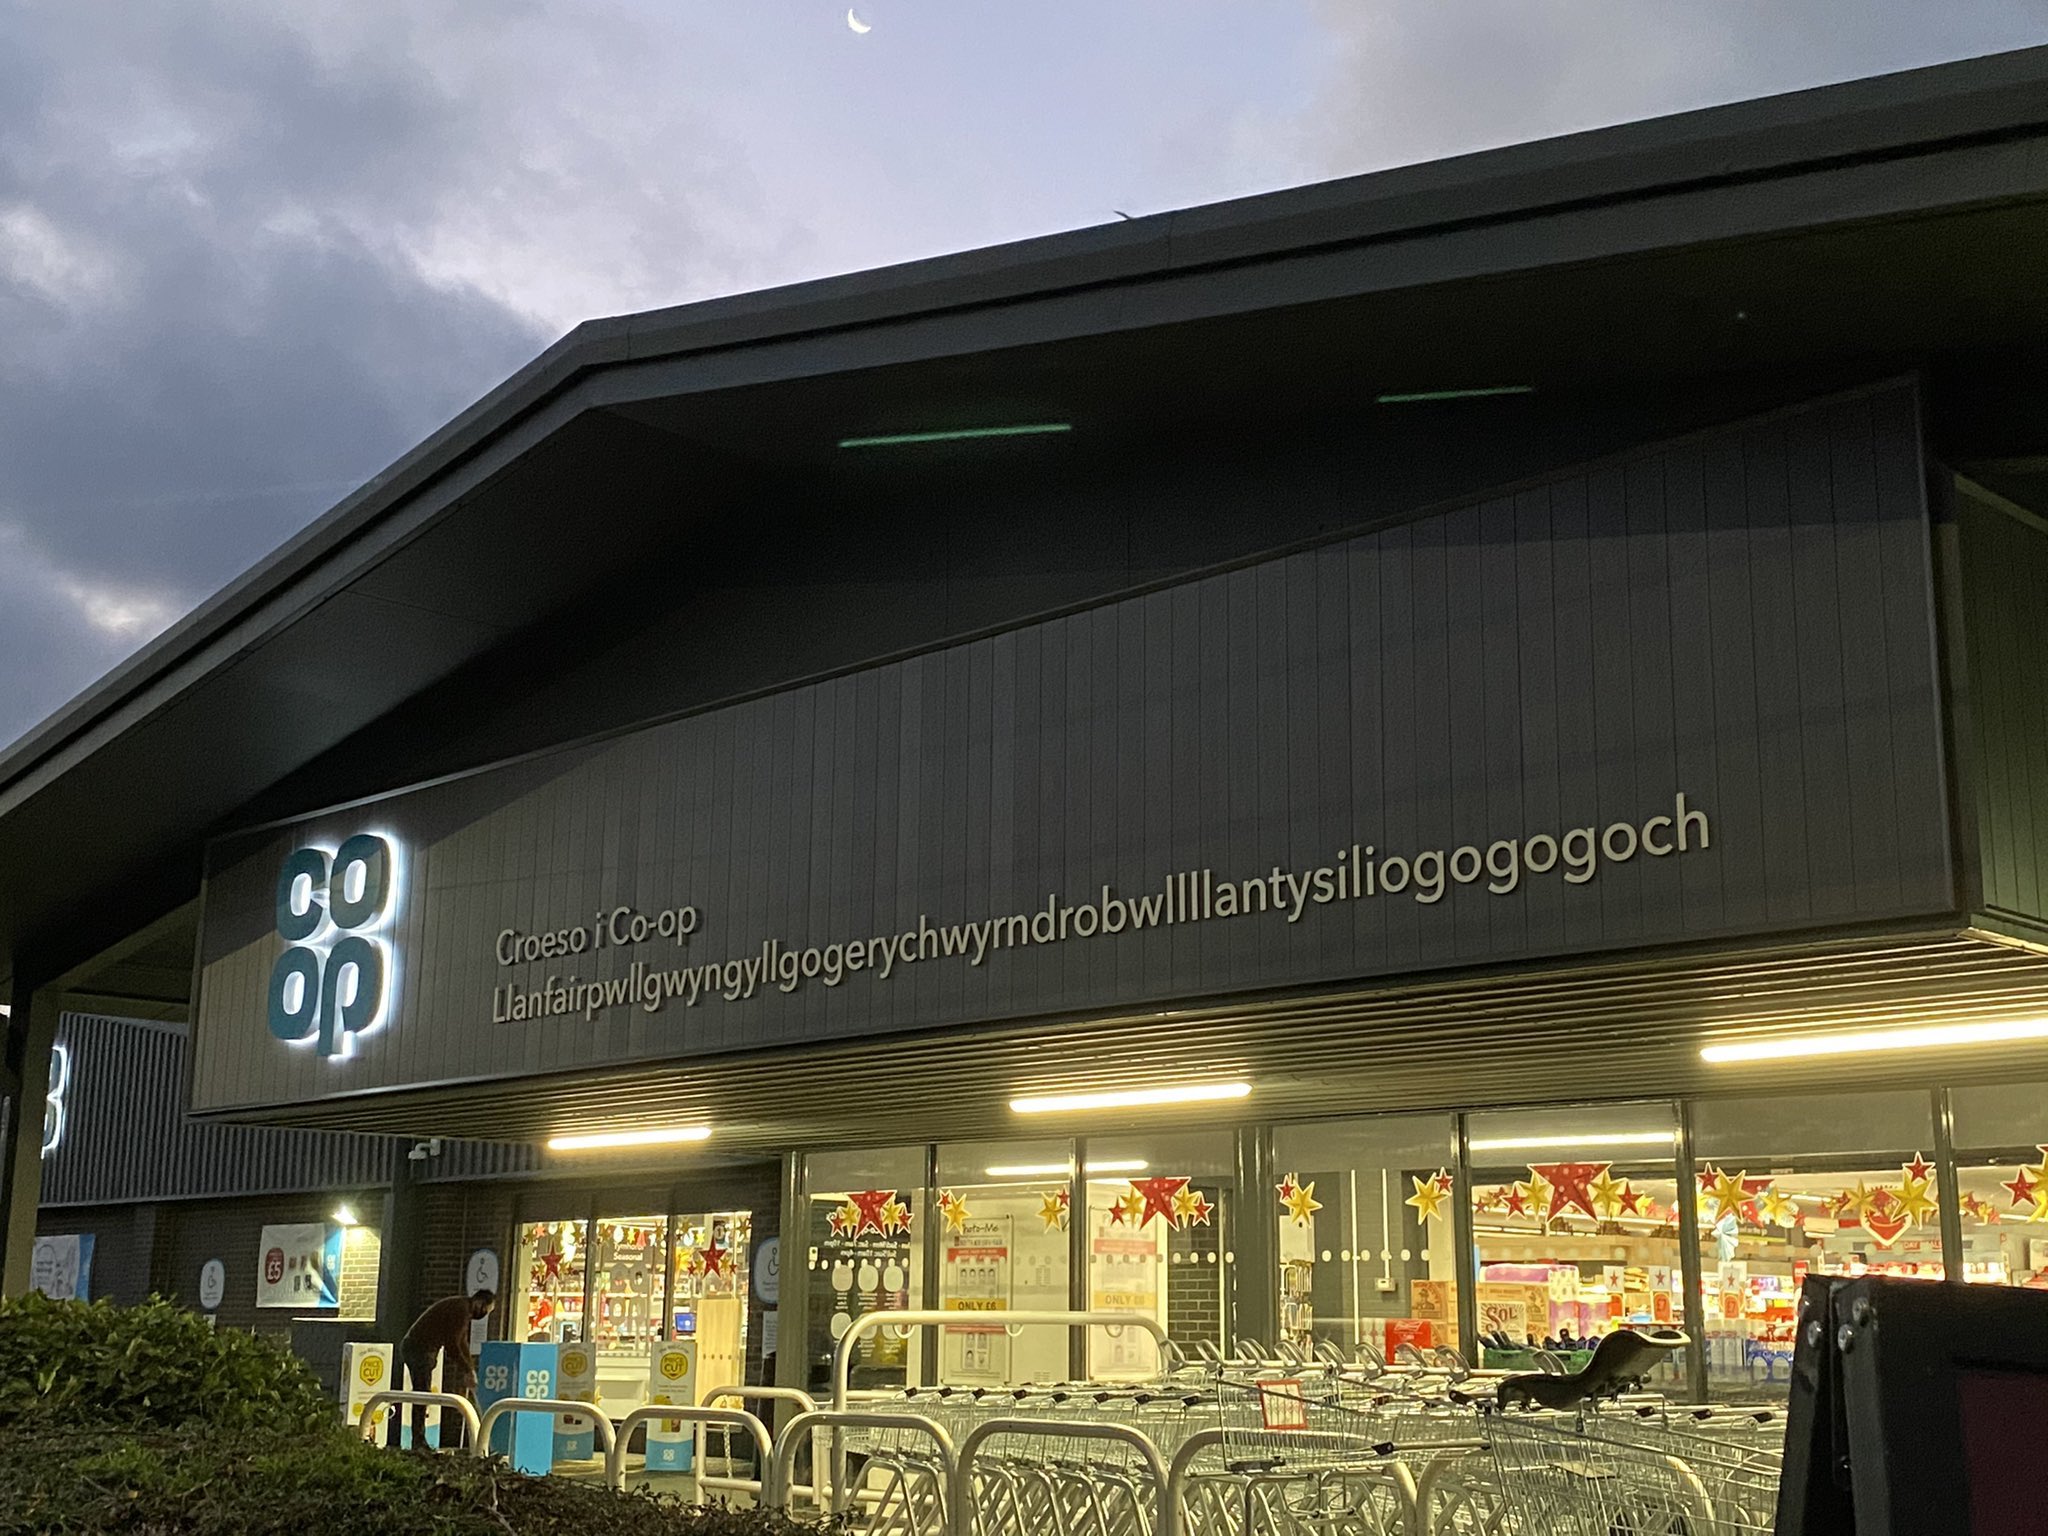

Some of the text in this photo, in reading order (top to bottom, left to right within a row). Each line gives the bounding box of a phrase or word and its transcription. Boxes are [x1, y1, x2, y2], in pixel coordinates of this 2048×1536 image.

[491, 791, 1711, 1023] Llanfairpwllgwyngyllgogerychwyrndrobwllllantysiliogogogoch
[496, 905, 698, 965] Croeso i Co-op
[962, 1223, 999, 1233] hoto-Me
[613, 1251, 643, 1261] Seasonal
[267, 1261, 281, 1280] £5
[957, 1301, 983, 1310] ONLY
[363, 1367, 380, 1378] CUT
[664, 1363, 684, 1372] CUT
